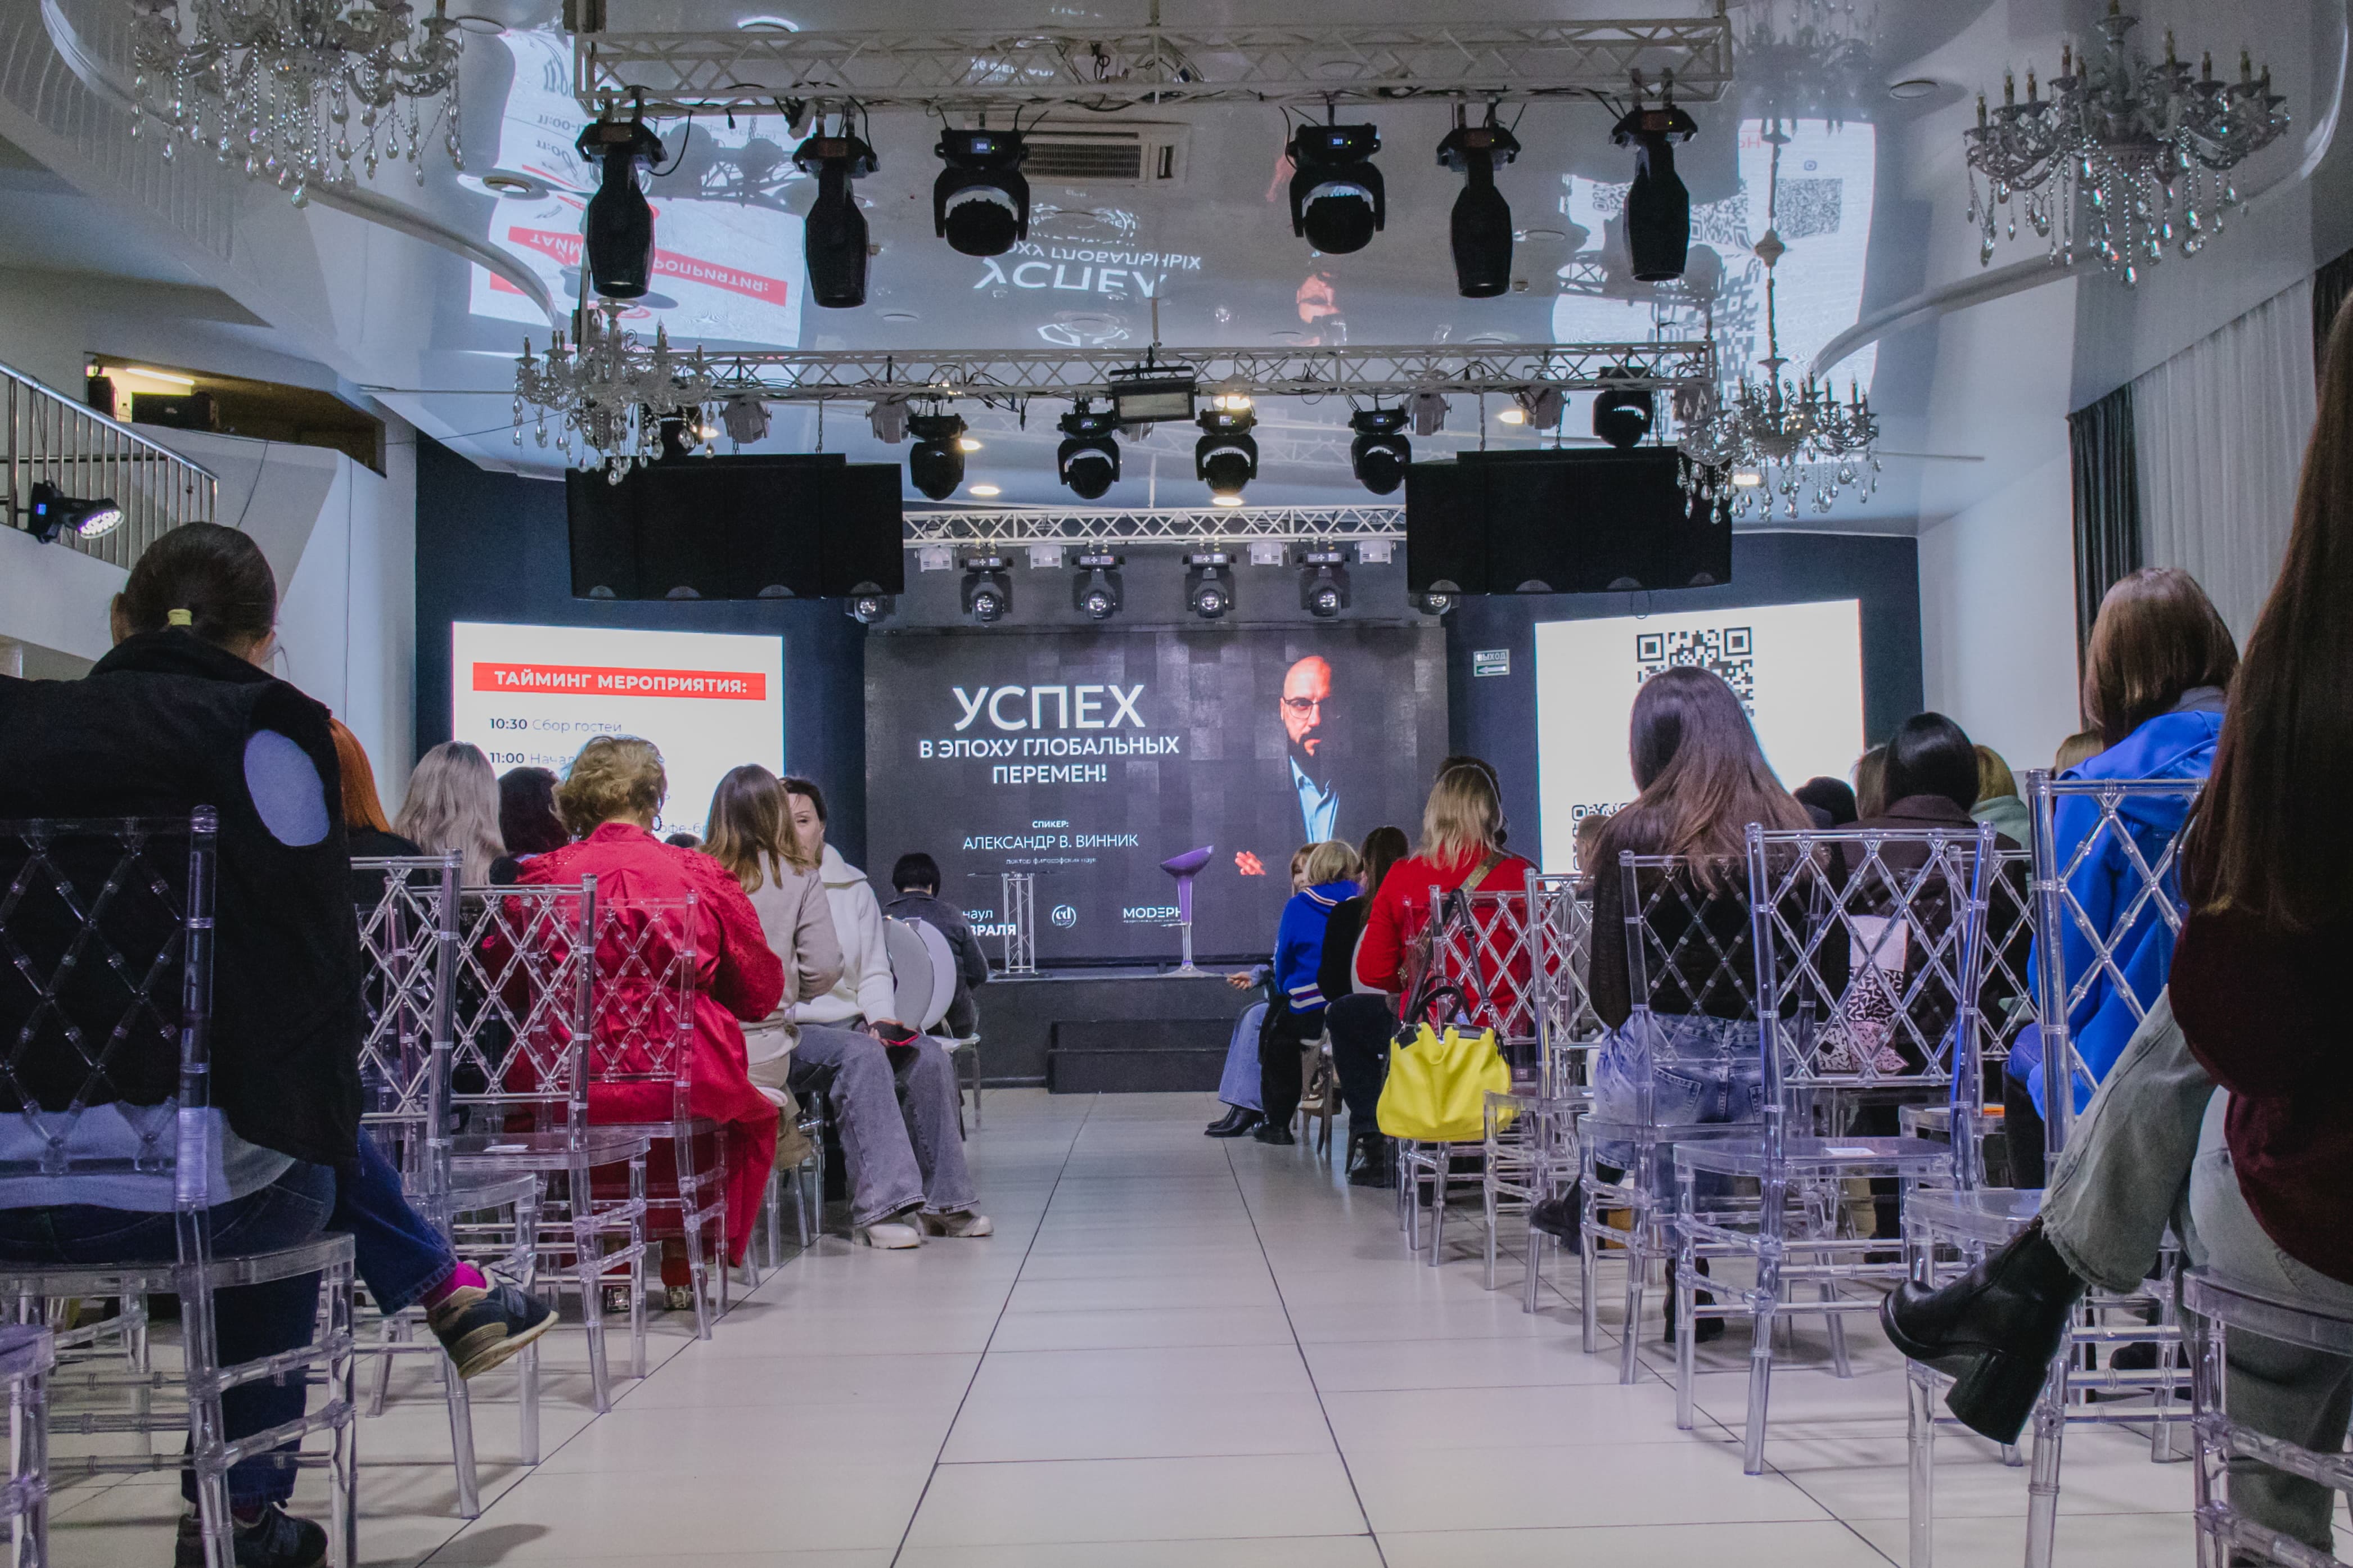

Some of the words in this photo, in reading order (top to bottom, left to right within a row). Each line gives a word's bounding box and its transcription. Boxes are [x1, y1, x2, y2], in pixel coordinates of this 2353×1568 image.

[1477, 652, 1506, 662] ВЫХОД
[494, 668, 592, 688] ТАЙМИНГ
[598, 675, 747, 693] МЕРОПРИЯТИЯ:
[953, 684, 1146, 731] УСПЕХ
[490, 718, 528, 730] 10:30
[532, 719, 570, 733] Сбор
[919, 740, 934, 758] В
[938, 738, 1018, 758] ЭПОХУ
[1023, 736, 1180, 756] ГЛОБАЛЬНЫХ
[490, 752, 525, 763] 11:00
[530, 753, 576, 765] Начал
[993, 765, 1107, 784] ПЕРЕМЕН!
[1032, 820, 1069, 829] СПИКЕР:
[963, 835, 1055, 851] АЛЕКСАНДР
[1060, 835, 1072, 848] В.
[1076, 834, 1139, 848] ВИННИК
[962, 910, 993, 922] наул
[970, 924, 1017, 936] ВРАЛЯ
